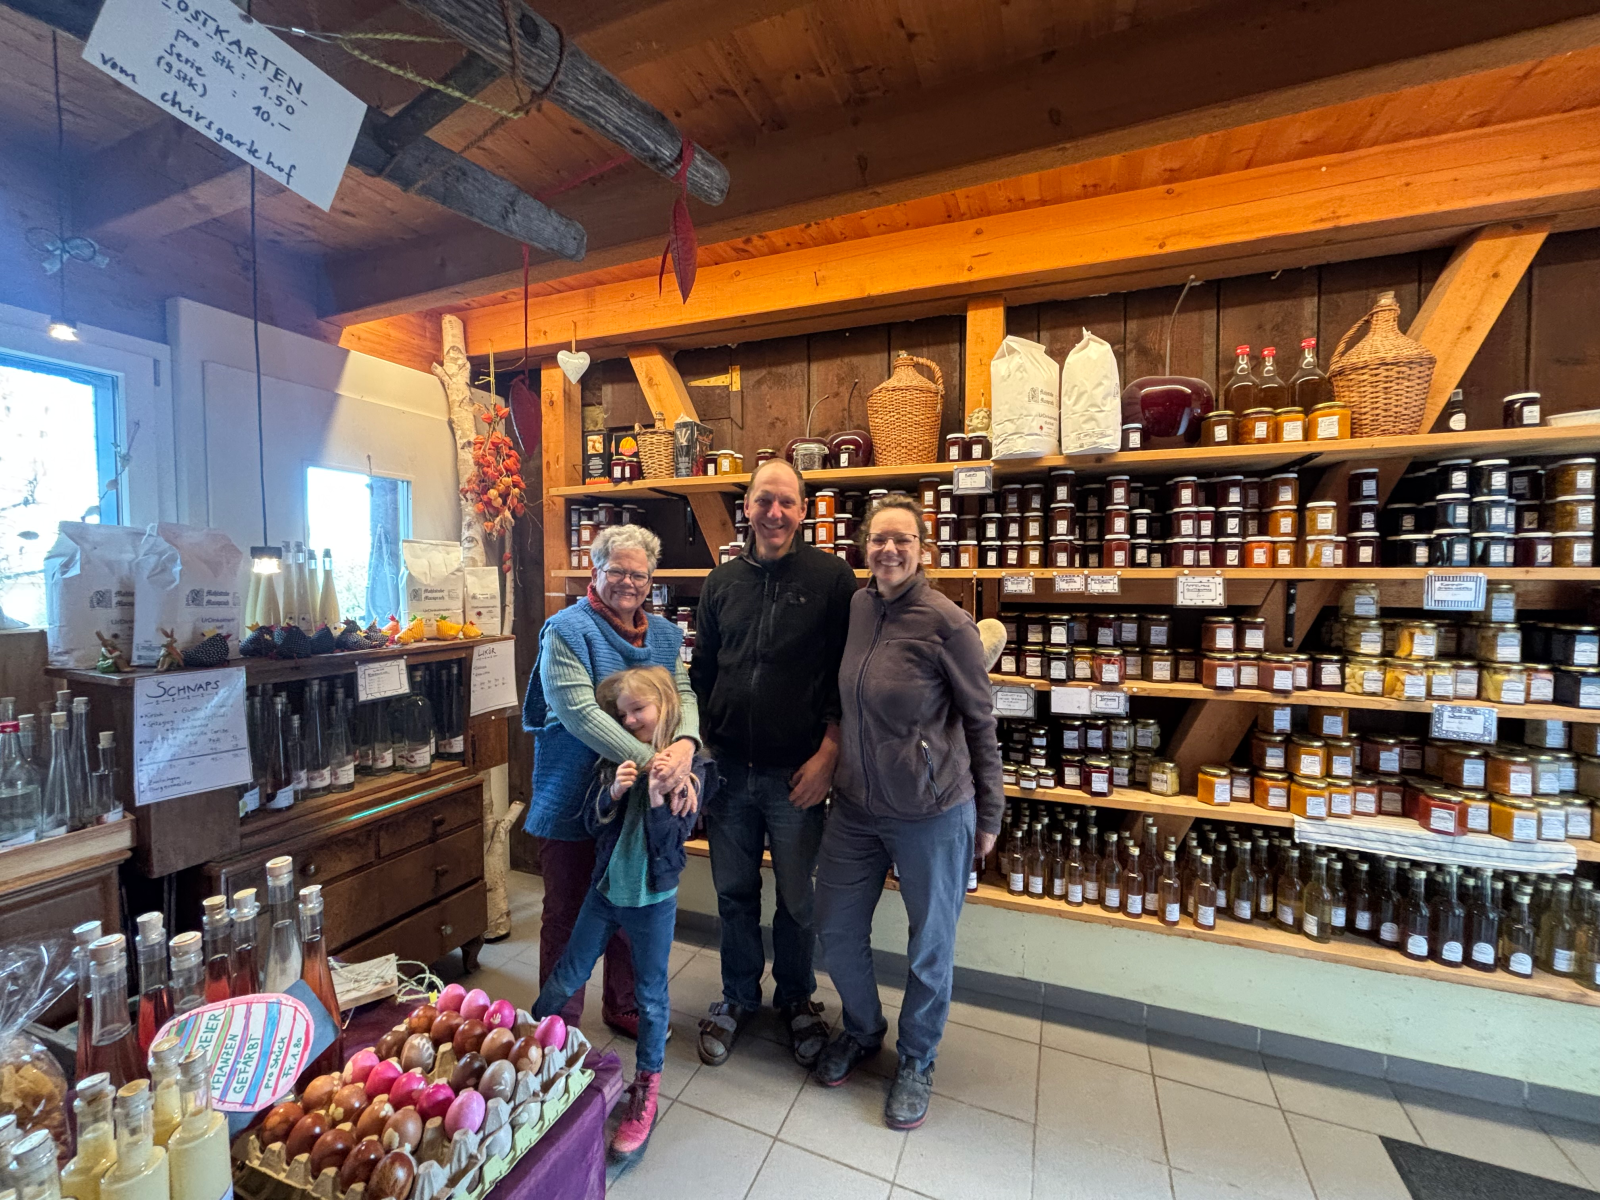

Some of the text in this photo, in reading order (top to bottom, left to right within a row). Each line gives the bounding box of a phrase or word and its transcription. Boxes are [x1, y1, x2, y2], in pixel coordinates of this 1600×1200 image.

[164, 43, 206, 77] Serie
[165, 0, 304, 95] OSTKARTEN
[260, 86, 296, 115] 1.50
[478, 646, 496, 657] LIKÖR
[145, 680, 221, 699] SCHNAPS
[196, 1013, 222, 1051] REIER
[211, 1034, 239, 1091] PFLANZEN
